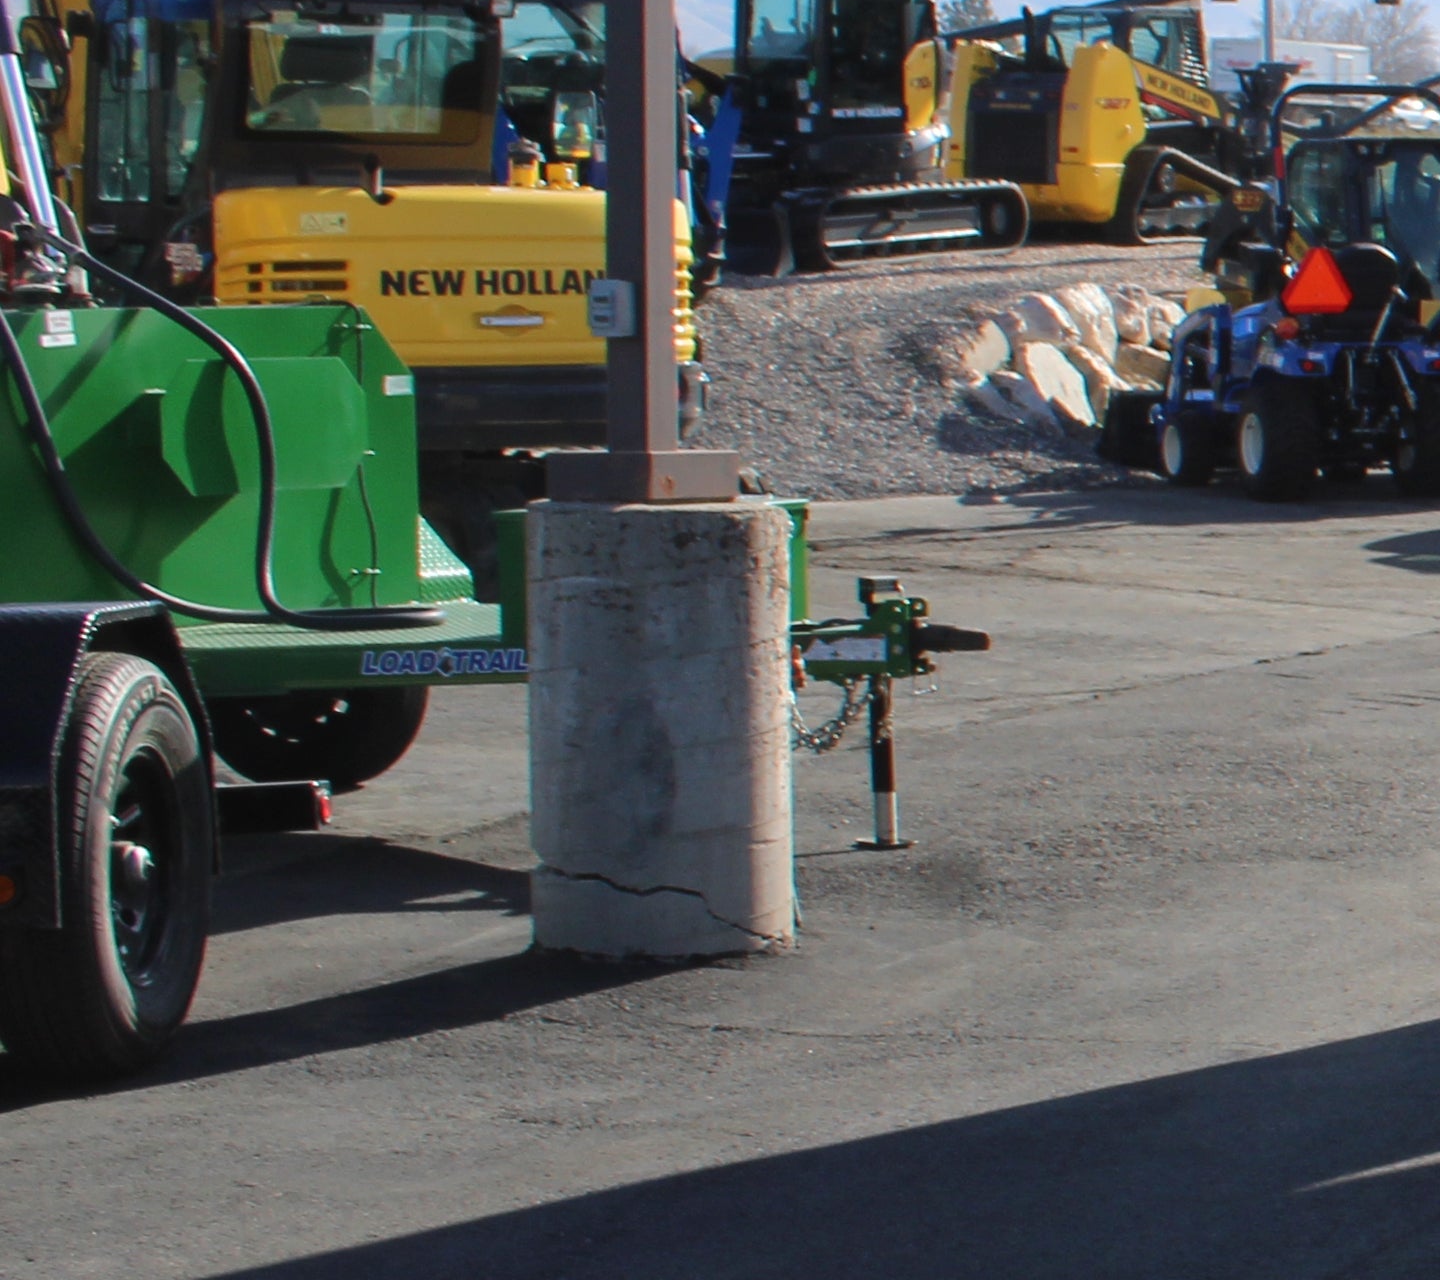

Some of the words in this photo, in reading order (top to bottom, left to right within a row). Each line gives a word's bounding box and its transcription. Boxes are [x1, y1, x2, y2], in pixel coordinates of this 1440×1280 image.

[380, 270, 465, 297] NEW
[362, 650, 438, 676] LOAD
[448, 648, 530, 673] TRAIL
